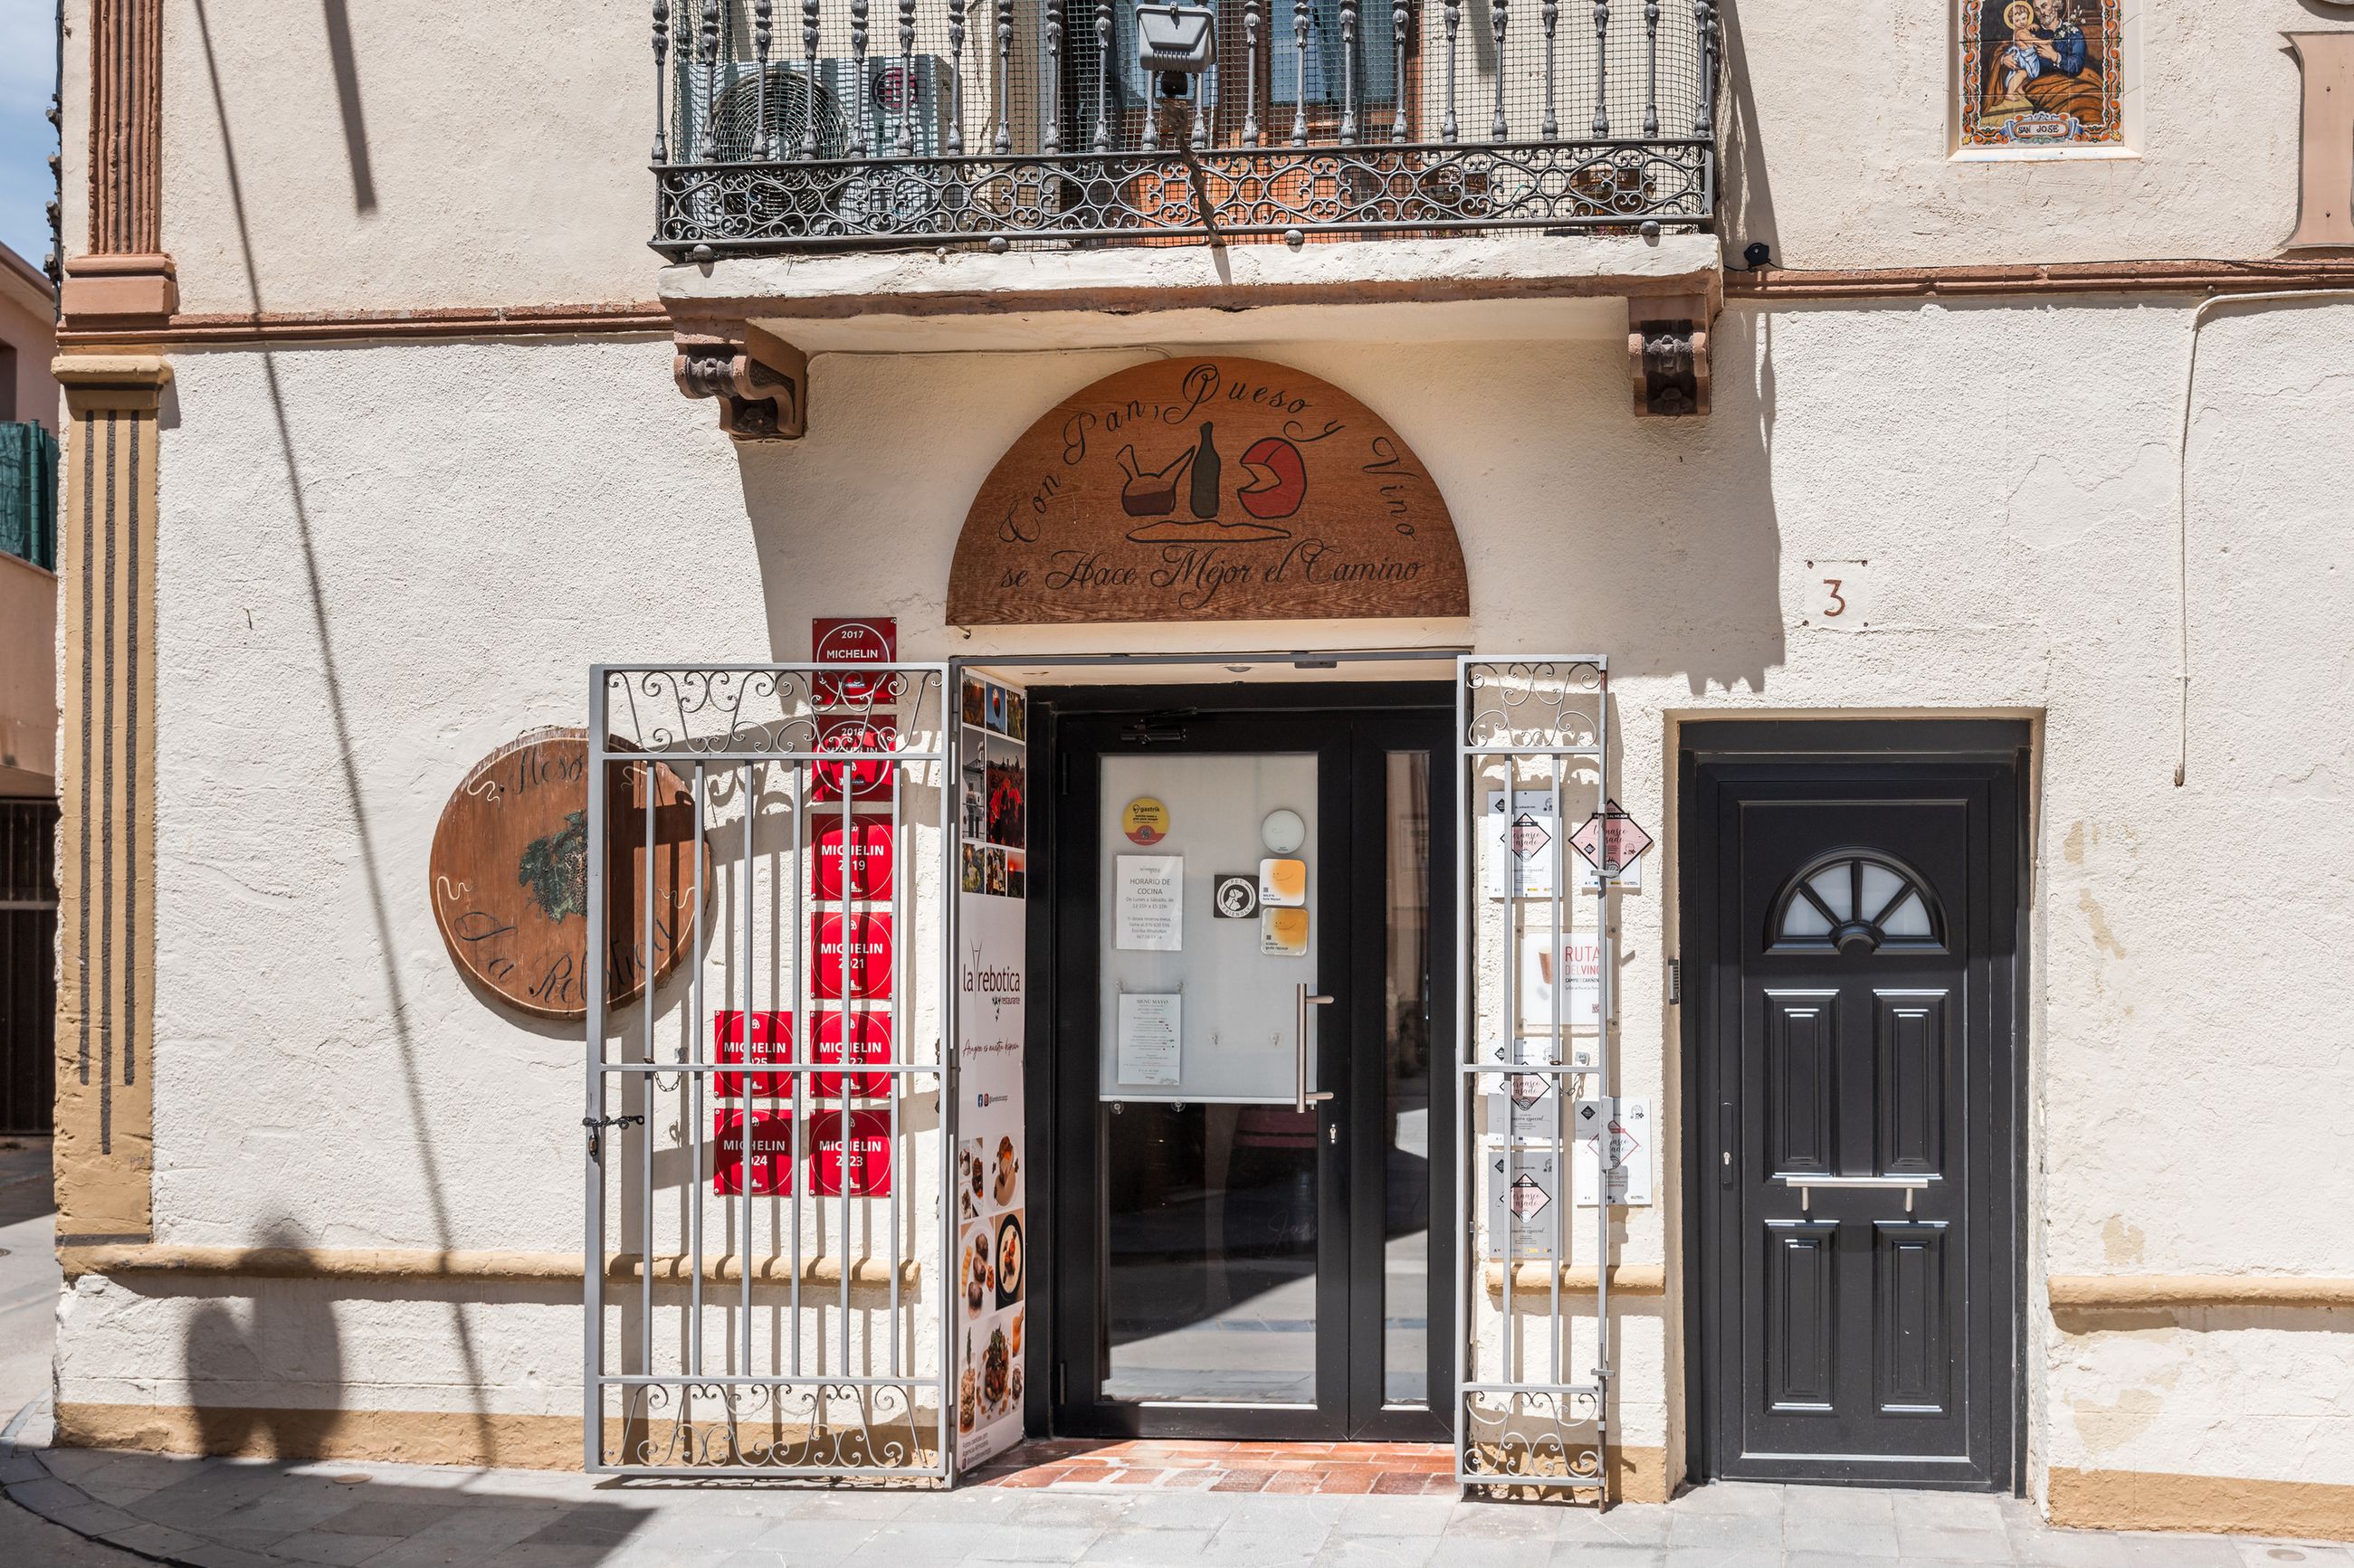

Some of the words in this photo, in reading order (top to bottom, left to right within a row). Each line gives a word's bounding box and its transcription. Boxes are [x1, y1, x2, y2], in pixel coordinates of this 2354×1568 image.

[2017, 126, 2031, 134] SAN
[998, 473, 1061, 544] Con
[1063, 396, 1159, 466] Pan,
[1283, 419, 1346, 442] y
[1361, 436, 1422, 541] Vino
[1000, 569, 1028, 590] se
[1044, 550, 1136, 589] Hace
[1149, 545, 1253, 610] Mejor
[1264, 543, 1298, 584] el
[1298, 538, 1424, 583] Camino
[1823, 579, 1846, 617] 3
[841, 630, 864, 639] 2017
[826, 649, 878, 659] MICHELIN
[841, 727, 864, 736] 2018
[838, 860, 866, 871] 219
[1222, 906, 1252, 917] FRIENDLY
[1565, 946, 1600, 962] RUTA
[838, 958, 864, 969] 221
[963, 963, 973, 992] la
[977, 964, 1020, 992] rebotica
[740, 1155, 768, 1166] 24
[836, 1155, 863, 1166] 223
